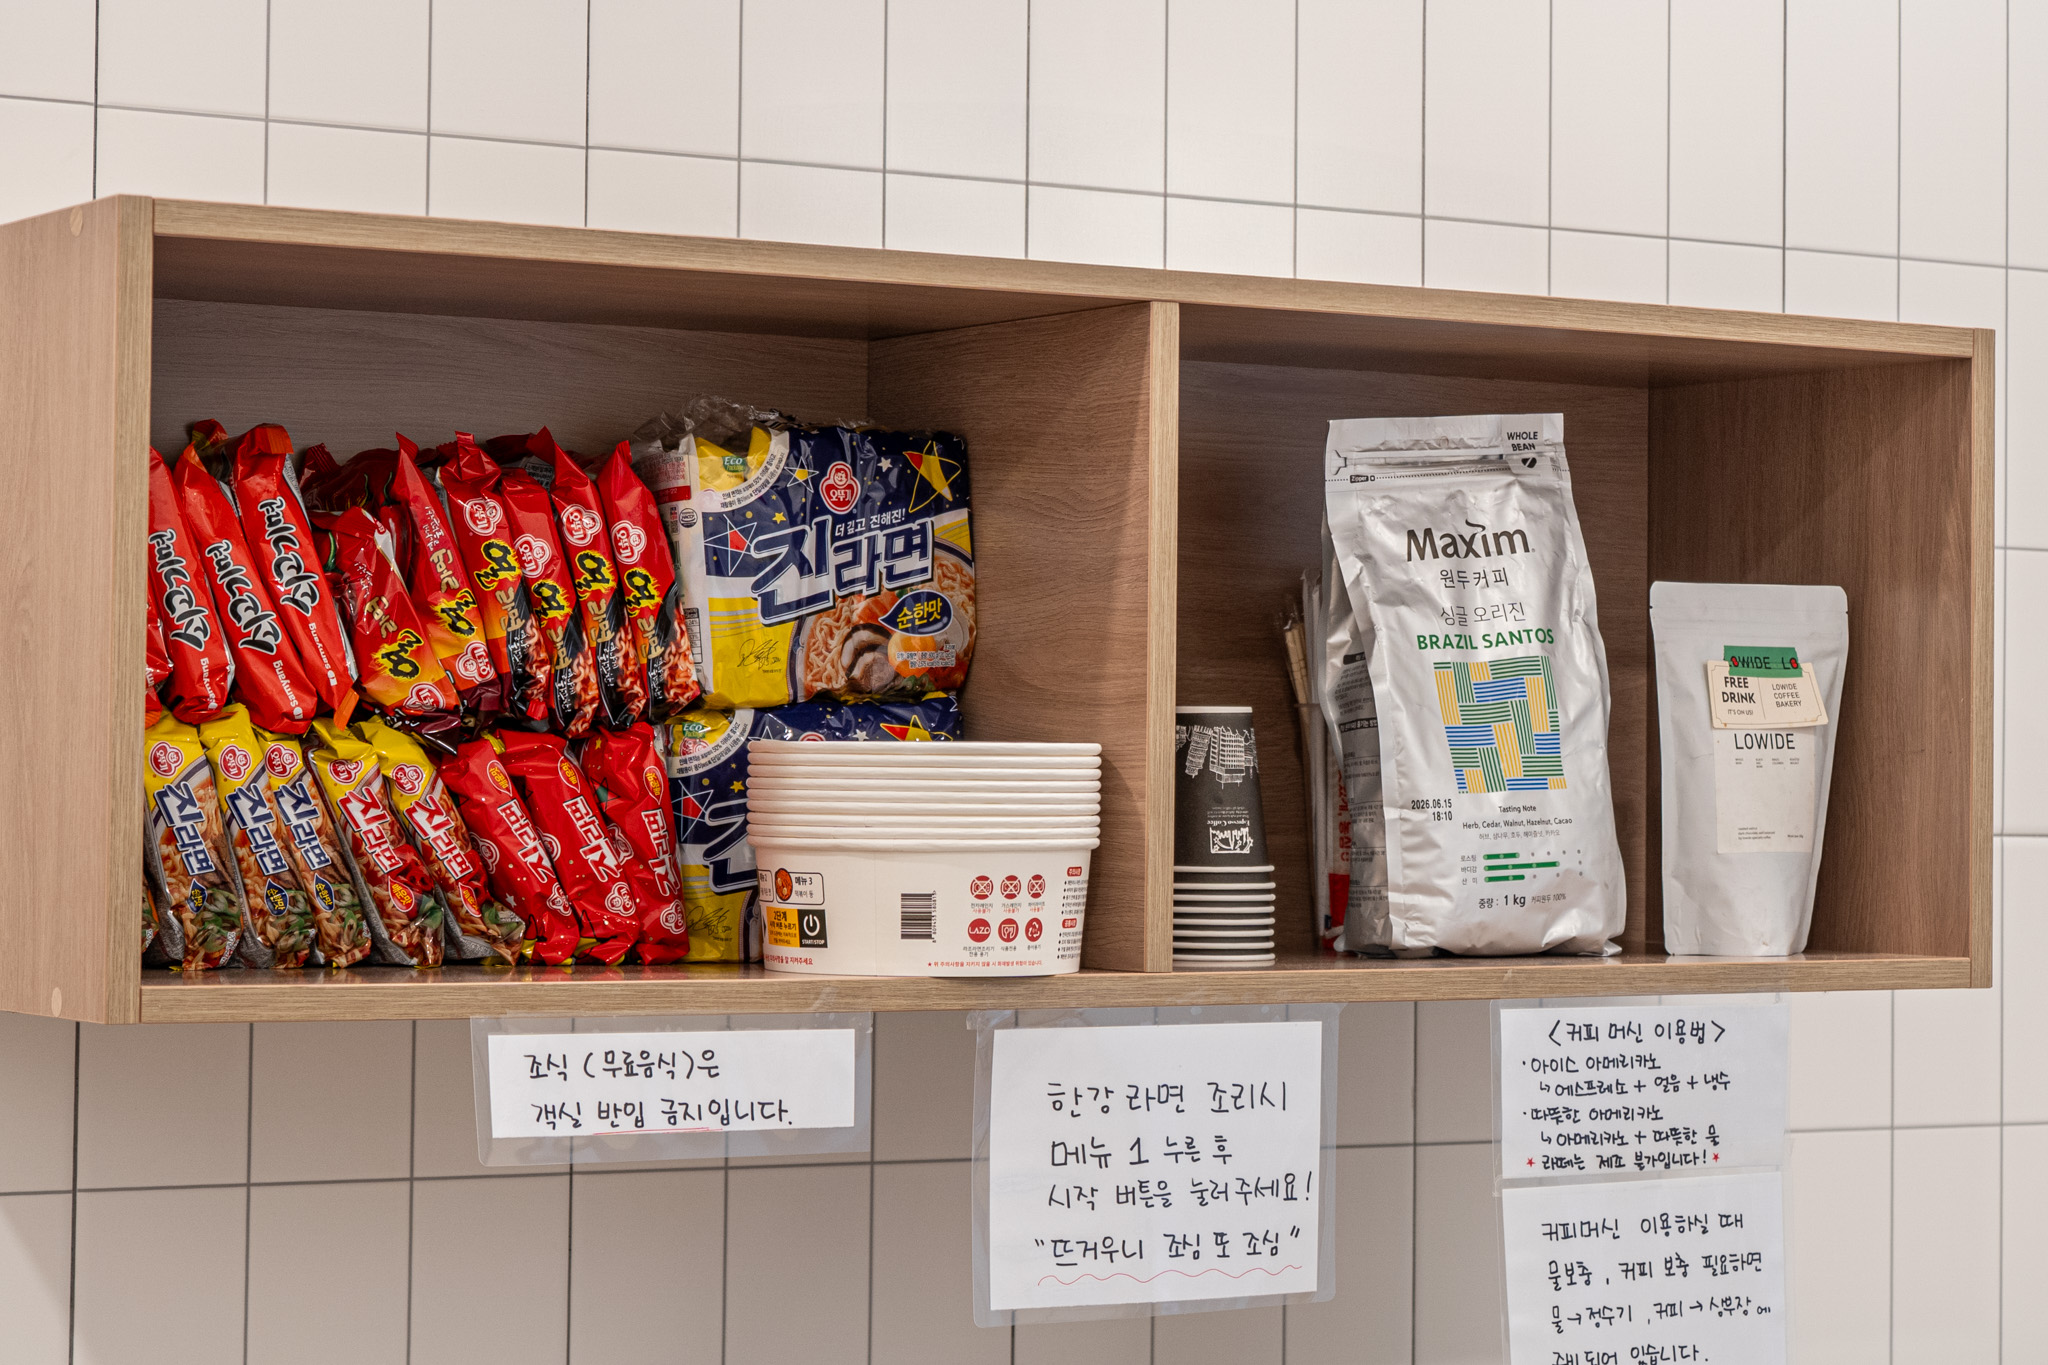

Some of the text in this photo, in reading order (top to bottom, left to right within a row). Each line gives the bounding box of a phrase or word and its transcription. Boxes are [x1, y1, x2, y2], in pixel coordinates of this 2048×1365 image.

[1506, 431, 1539, 441] WHOLE
[1511, 443, 1537, 451] BEAN
[830, 489, 851, 502] 오뚜기
[470, 502, 488, 530] 오뚜기
[570, 510, 586, 540] 오뚜기
[835, 509, 906, 537] 더 깊고 진해진!
[617, 529, 632, 560] 오뚜기
[1406, 519, 1530, 562] Maxim
[257, 496, 320, 616] 쇠고기면
[520, 544, 536, 571] 오뚜기
[750, 515, 934, 627] 진라면
[1440, 567, 1509, 590] 원두커피
[149, 528, 211, 652] 쇠고기면
[205, 539, 282, 655] 쇠고기면
[896, 598, 943, 630] 순한맛
[1440, 602, 1526, 627] 싱글 오리진
[309, 622, 331, 671] Samyang
[1416, 628, 1554, 650] BRAZIL SANTOS
[472, 645, 494, 679] 오뚜기
[200, 657, 216, 703] Samyang
[273, 659, 299, 708] Samyang
[1724, 676, 1749, 688] FREE
[1722, 692, 1756, 704] DRINK
[1734, 733, 1796, 750] LOWIDE
[154, 749, 171, 772] 오뚜기
[225, 753, 241, 777] 오뚜기
[271, 750, 284, 772] 오뚜기
[561, 761, 579, 786] 매운맛
[395, 769, 412, 791] 오뚜기
[488, 765, 509, 790] 매운맛
[650, 771, 662, 797] 매운맛
[1411, 798, 1452, 810] 2026.06.15
[1432, 811, 1453, 822] 18:10
[1498, 804, 1537, 814] Tasting Note
[154, 782, 215, 875] 진라면
[226, 784, 289, 875] 진라면
[275, 782, 332, 870] 진라면
[337, 787, 402, 873] 진라면
[1462, 817, 1573, 830] Herb, Cedar, Walnut, Hazelnut, Cacao
[404, 795, 473, 881] 진라면
[497, 799, 556, 883] 진라면
[563, 796, 620, 882] 진라면
[641, 808, 680, 897] 진라면
[1460, 854, 1477, 862] 로스팅
[794, 876, 806, 886] 메뉴
[1460, 865, 1478, 874] 바디감
[315, 882, 334, 905] 순한맛
[391, 882, 413, 905] 매운맛
[621, 887, 634, 908] 오뚜기
[1513, 894, 1526, 907] kg
[1552, 893, 1566, 902] 100%
[968, 926, 990, 934] LAZO
[1608, 1021, 1643, 1044] 머신
[523, 1049, 720, 1082] 조식 (무료음식)은
[1586, 1053, 1662, 1071] 아메리카노
[1555, 1079, 1629, 1097] 에스프레소
[1654, 1074, 1681, 1094] 얼음
[1704, 1071, 1731, 1091] 냉수
[1047, 1081, 1287, 1118] 한강 라면 조리시
[531, 1098, 793, 1130] 객실 반입 금지입니다.
[1530, 1104, 1664, 1126] 따뜻한 아메리카노
[1556, 1130, 1629, 1147] 아메리카노
[1654, 1126, 1698, 1146] 따뜻한
[1705, 1124, 1720, 1146] 물
[1051, 1135, 1233, 1169] 메뉴 1 누른 후
[1542, 1148, 1708, 1171] 라떼는 제조 불가입니다!
[1048, 1184, 1099, 1211] 시작
[1116, 1179, 1172, 1209] 버튼을
[1541, 1212, 1744, 1241] 커피머신 이용하실 때
[1163, 1233, 1200, 1260] 조심
[1213, 1232, 1230, 1258] 또
[1618, 1261, 1653, 1281] 커피
[1664, 1252, 1690, 1278] 보충
[1701, 1252, 1762, 1277] 필요하면
[1551, 1305, 1564, 1334] 물
[1586, 1304, 1632, 1328] 정수기
[1653, 1300, 1683, 1320] 커피
